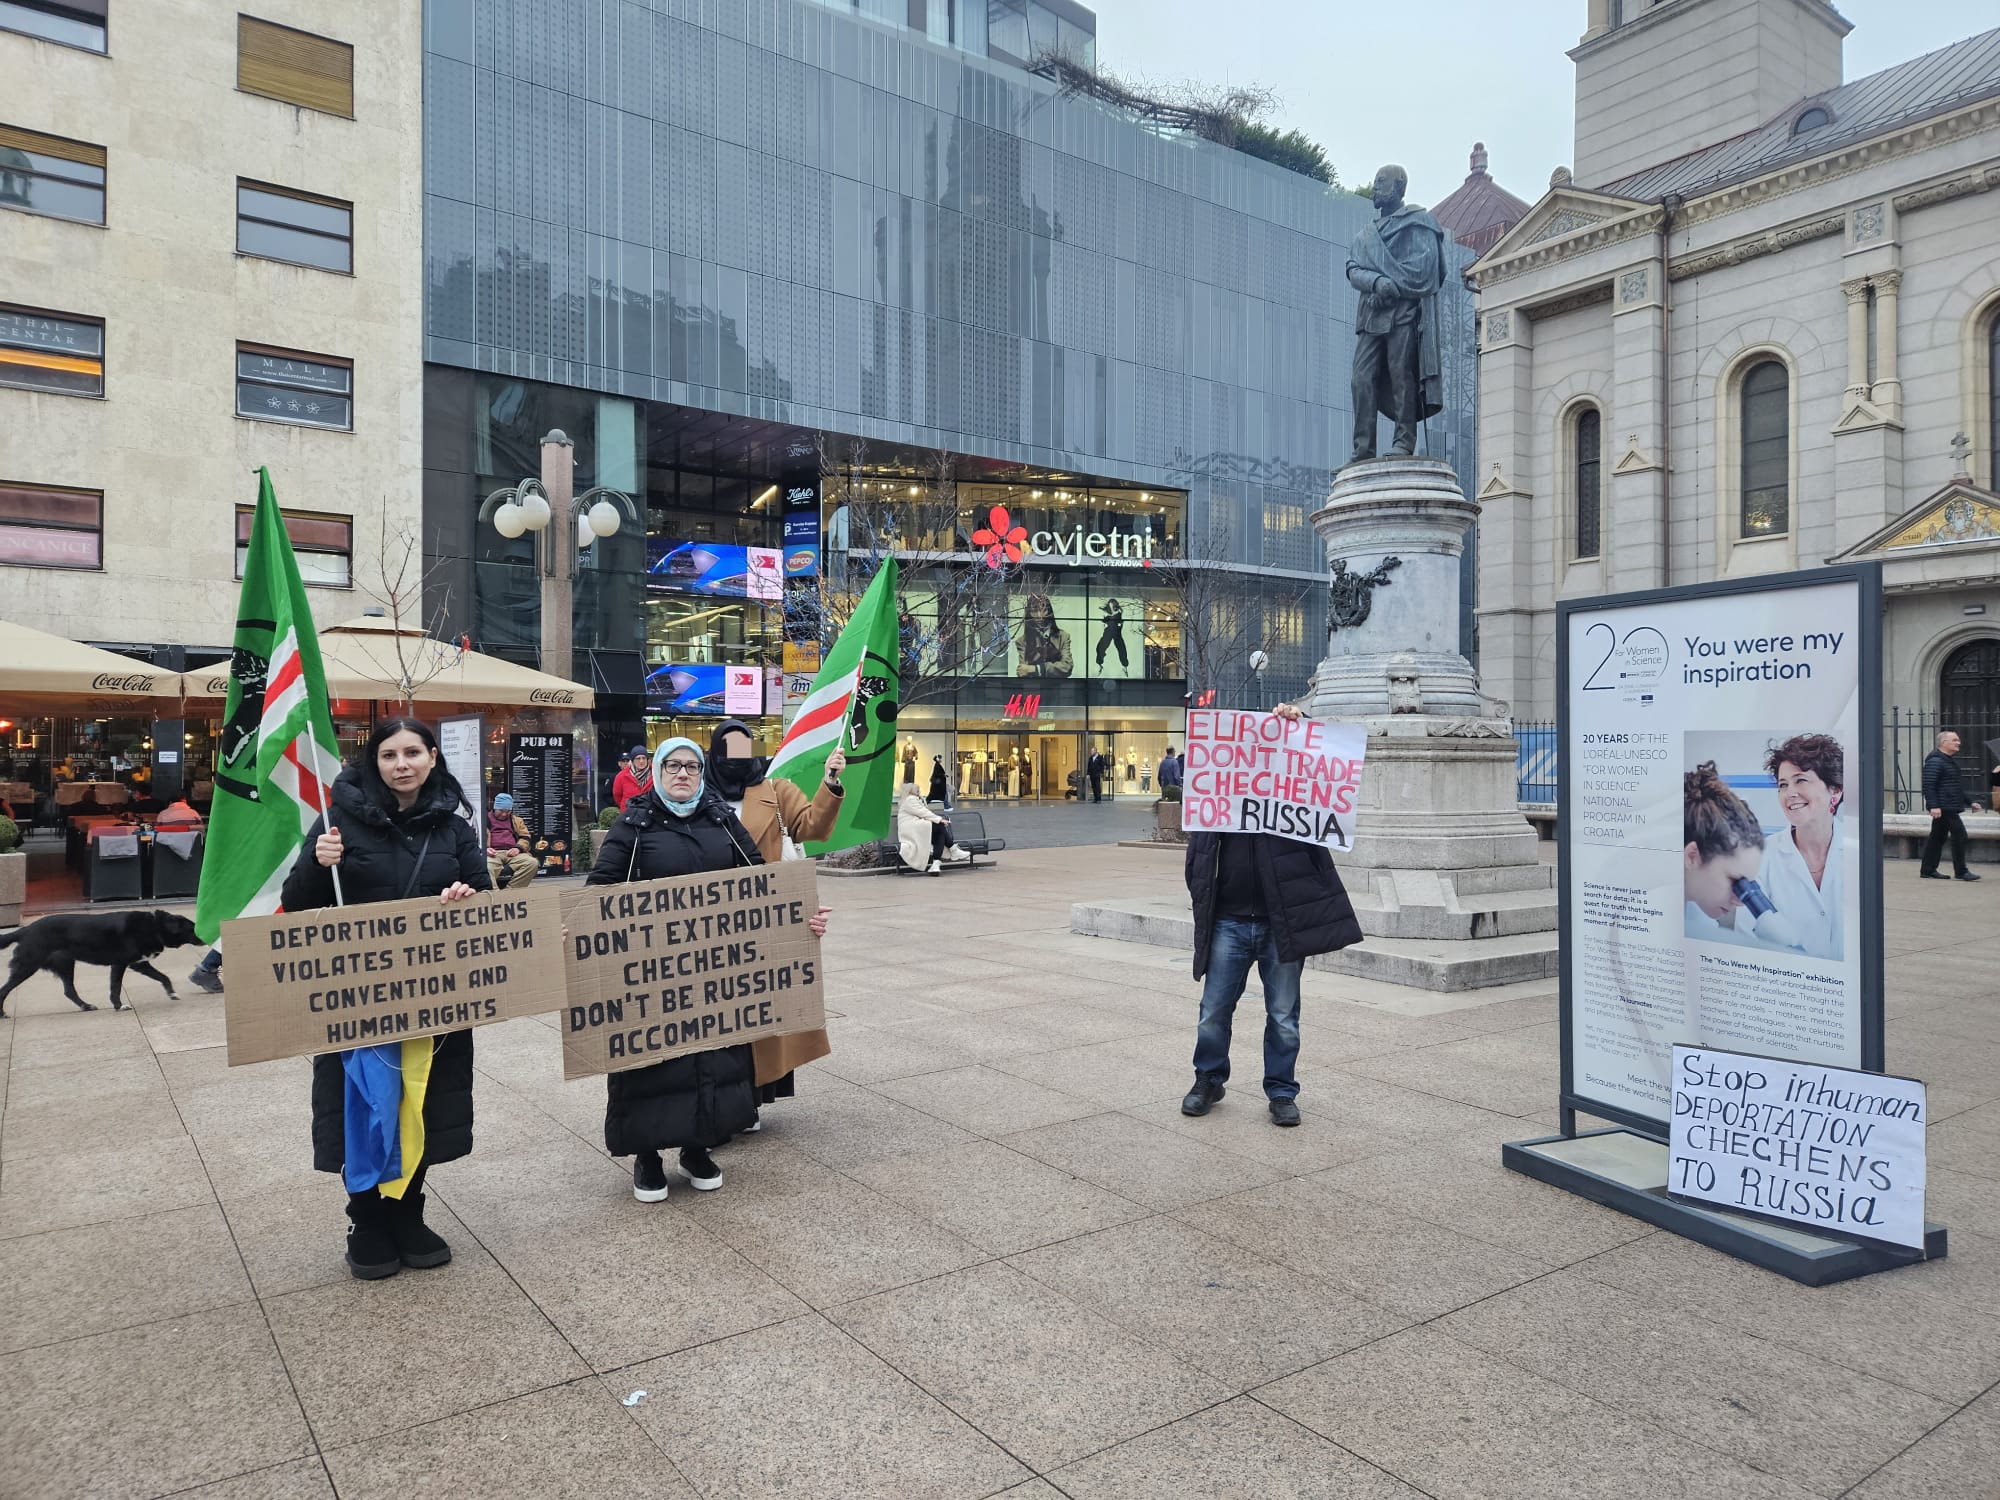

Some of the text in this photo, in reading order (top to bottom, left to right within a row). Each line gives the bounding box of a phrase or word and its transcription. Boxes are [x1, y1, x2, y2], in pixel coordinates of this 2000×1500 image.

[12, 316, 60, 331] THAI
[263, 359, 326, 375] MALI
[787, 487, 814, 500] Kiehl's
[1031, 525, 1152, 566] cvjetni
[789, 557, 811, 565] PEPCO
[1099, 559, 1143, 567] SUPERNOVA
[1626, 646, 1660, 656] Women
[1684, 632, 1844, 658] You were my
[1632, 655, 1662, 666] Science
[1683, 658, 1811, 688] inspiration
[791, 679, 810, 691] dm
[1003, 694, 1041, 719] H&M
[1188, 711, 1325, 750] EUROPE
[1583, 733, 1669, 744] 20 YEARS OF THE
[520, 737, 547, 747] PUB
[1583, 747, 1668, 760] L'ORÉAL-UNESCO
[1187, 743, 1365, 785] DON'T TRADE
[1608, 765, 1648, 776] WOMEN
[1191, 770, 1356, 814] CHECHENS
[1583, 780, 1593, 790] IN
[1583, 796, 1632, 807] NATIONAL
[1184, 796, 1349, 848] FOR RUSSIA
[1583, 811, 1646, 824] PROGRAM IN
[1583, 826, 1625, 839] CROATIA
[1583, 881, 1604, 890] Science
[600, 873, 777, 920] KAZAKHSTAN:
[1583, 918, 1608, 926] moment
[1642, 908, 1663, 917] begins
[270, 901, 528, 950] DEPORTING CHECHENS
[575, 901, 804, 960] DON'T EXTRADITE
[272, 929, 533, 983] VIOLATES THE GENEVA
[624, 940, 765, 986] CHECHENS.
[1700, 955, 1713, 963] The
[1731, 960, 1749, 969] Were
[1750, 963, 1761, 973] My
[1805, 973, 1844, 986] exhibition
[309, 965, 508, 1013] CONVENTION AND
[570, 961, 815, 1032] DON'T BE RUSSIA'S
[1753, 996, 1776, 1005] award
[1778, 1001, 1807, 1012] winners
[1808, 1005, 1824, 1015] and
[1799, 993, 1830, 1006] Through
[1831, 998, 1845, 1008] the
[327, 998, 497, 1043] HUMAN RIGHTS
[609, 1001, 782, 1058] ACCOMPLICE.
[1715, 1027, 1755, 1042] generations
[1742, 1022, 1766, 1033] female
[1766, 1029, 1795, 1042] support
[1796, 1033, 1812, 1043] that
[1808, 1026, 1845, 1041] celebrate
[1585, 1072, 1617, 1090] Because
[1617, 1083, 1631, 1094] the
[1632, 1088, 1655, 1101] world
[1627, 1072, 1648, 1087] Meet
[1649, 1079, 1663, 1092] the
[1683, 1055, 1924, 1124] Stop inhuman
[1687, 1125, 1892, 1191] CHECHENS
[1676, 1157, 1716, 1192] TO
